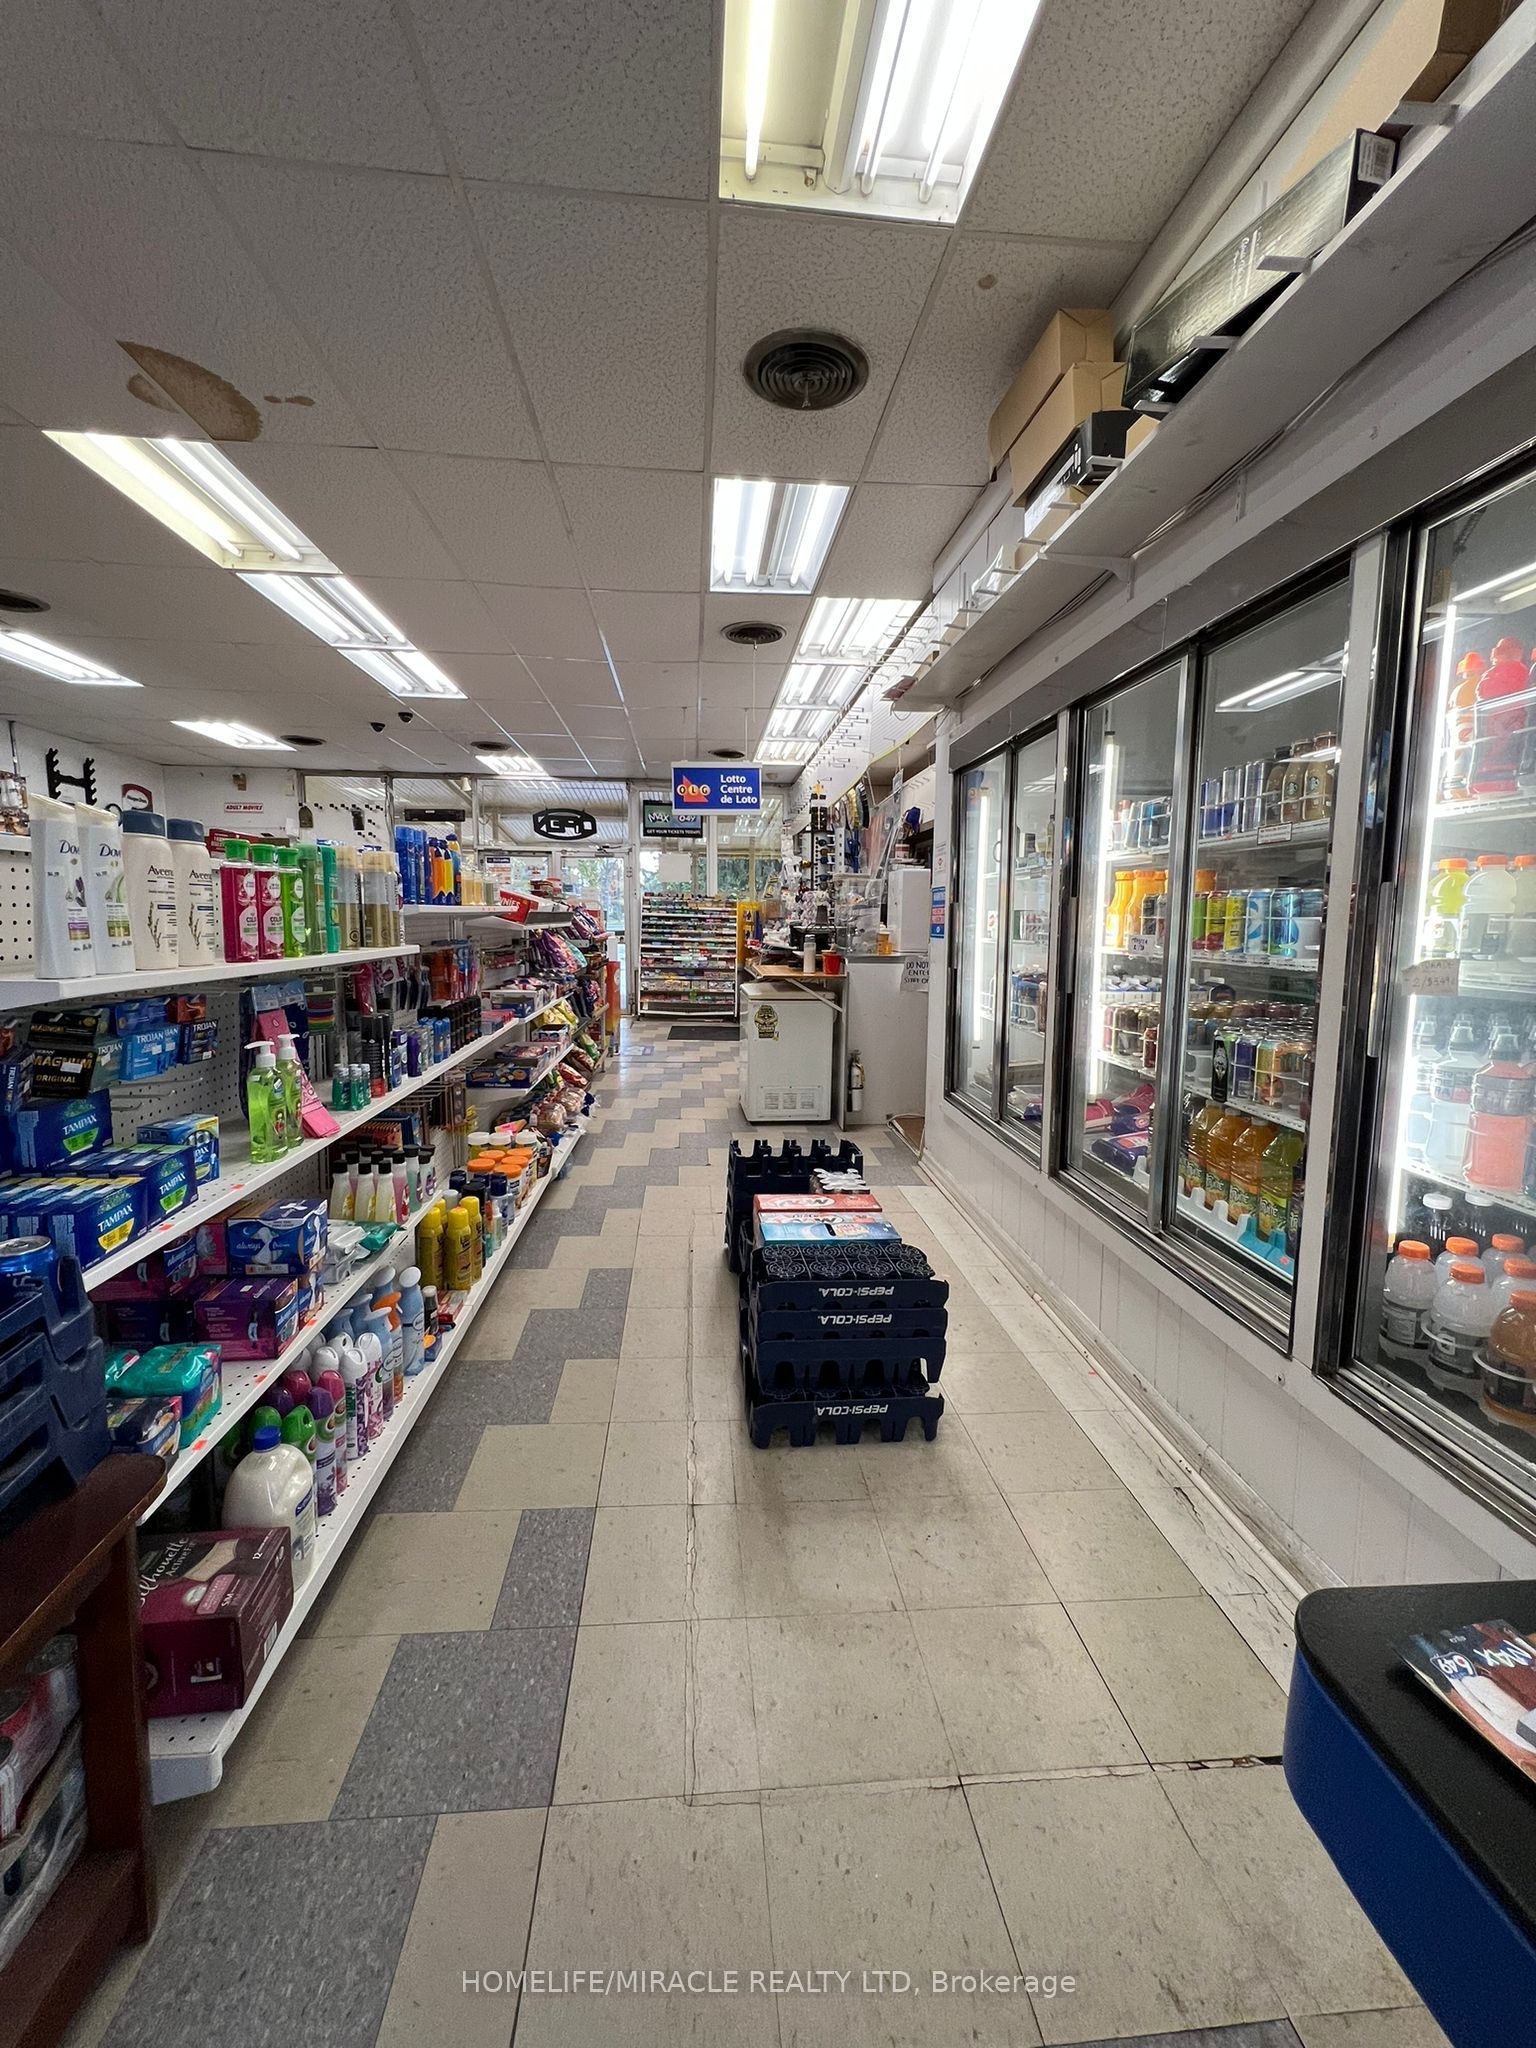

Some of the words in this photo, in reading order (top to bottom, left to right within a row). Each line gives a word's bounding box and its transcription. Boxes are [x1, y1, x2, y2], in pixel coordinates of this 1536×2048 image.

[720, 774, 746, 783] Lotto
[677, 785, 710, 795] OLG
[720, 785, 752, 794] Centre
[720, 795, 733, 804] de
[736, 795, 758, 804] Loto
[907, 961, 915, 970] DO
[193, 1021, 217, 1032] TROJAN
[137, 1032, 164, 1044] TROJAN
[36, 1074, 76, 1084] ORIGINAL
[62, 1113, 98, 1136] TAMPAX
[159, 1171, 187, 1195] TAMPAX
[97, 1202, 134, 1233] TAMPAX
[1472, 1639, 1533, 1667] MAX
[1437, 1654, 1474, 1676] 649
